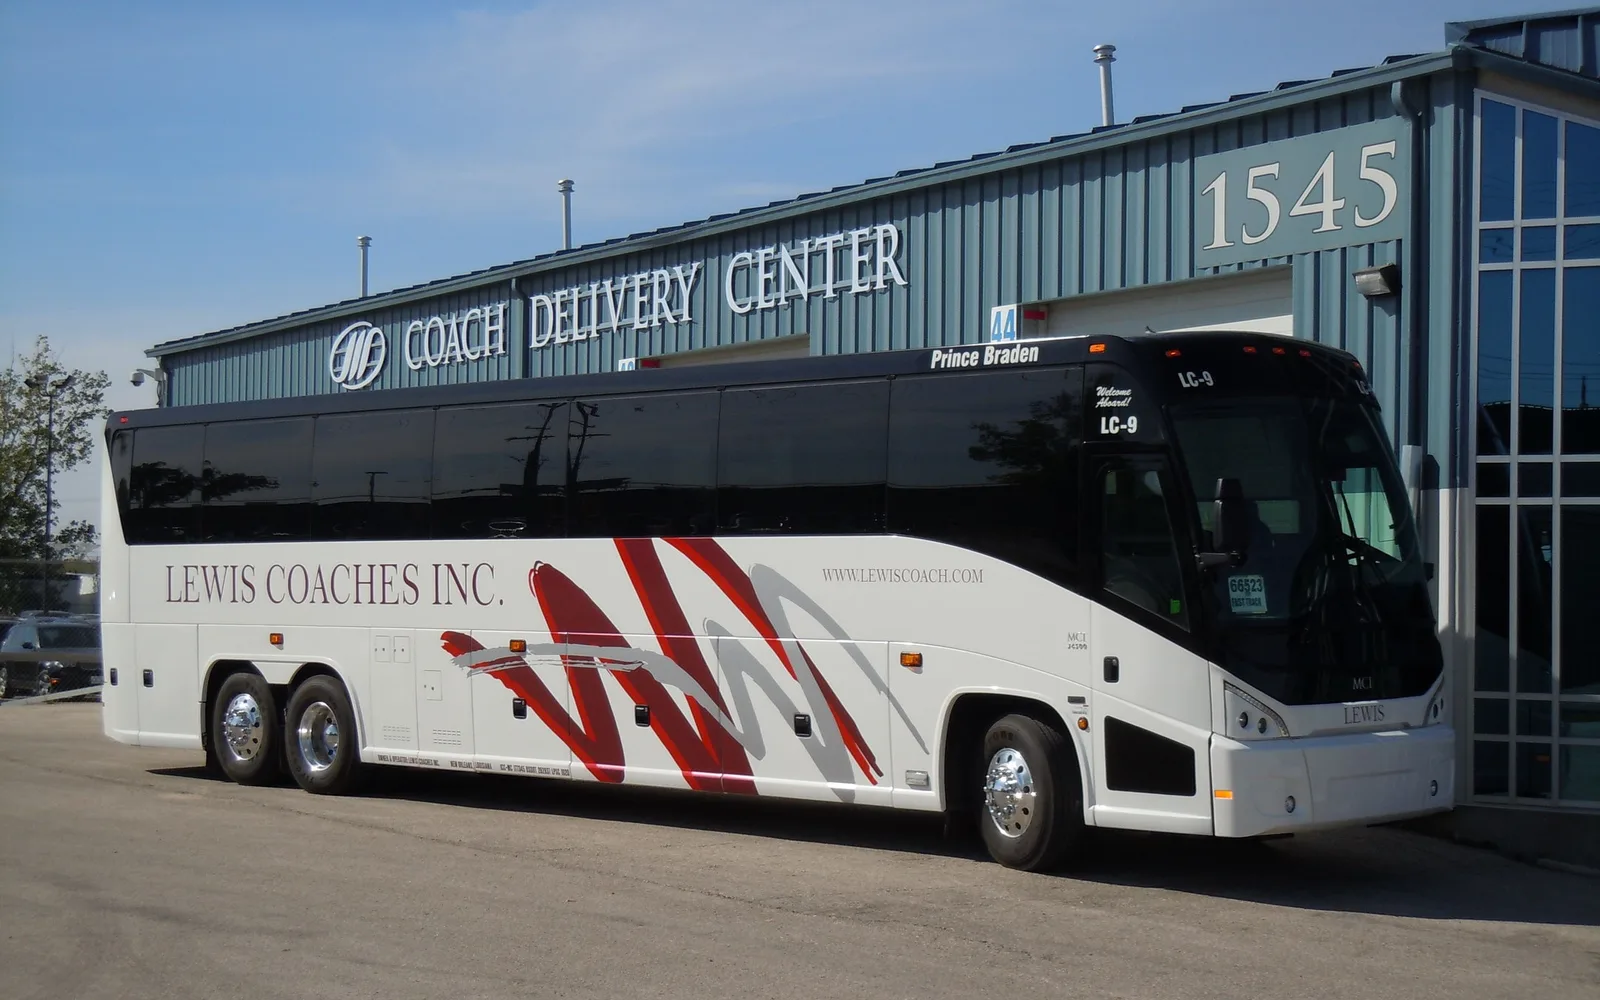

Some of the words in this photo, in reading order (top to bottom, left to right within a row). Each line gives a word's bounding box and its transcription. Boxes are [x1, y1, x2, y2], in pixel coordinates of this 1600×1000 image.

[1201, 140, 1398, 250] 1545
[405, 303, 506, 370] COACH
[529, 261, 701, 349] DELIVERY
[725, 223, 908, 314] CENTER
[992, 309, 1016, 342] 44
[930, 349, 980, 369] Prince
[983, 344, 1039, 365] Braden
[1178, 371, 1214, 388] LC-9
[1096, 386, 1132, 396] Welcome
[1095, 397, 1132, 408] Aboard!
[1101, 416, 1138, 434] LC-9
[166, 564, 256, 604] LEWIS
[266, 563, 420, 605] COACHES
[432, 562, 504, 606] INC.
[822, 568, 984, 584] WWW.LEWISCOACH.COM
[1230, 578, 1263, 593] 66523
[1067, 632, 1086, 642] MCI
[1352, 676, 1373, 690] MCI
[1343, 704, 1386, 725] LEWIS
